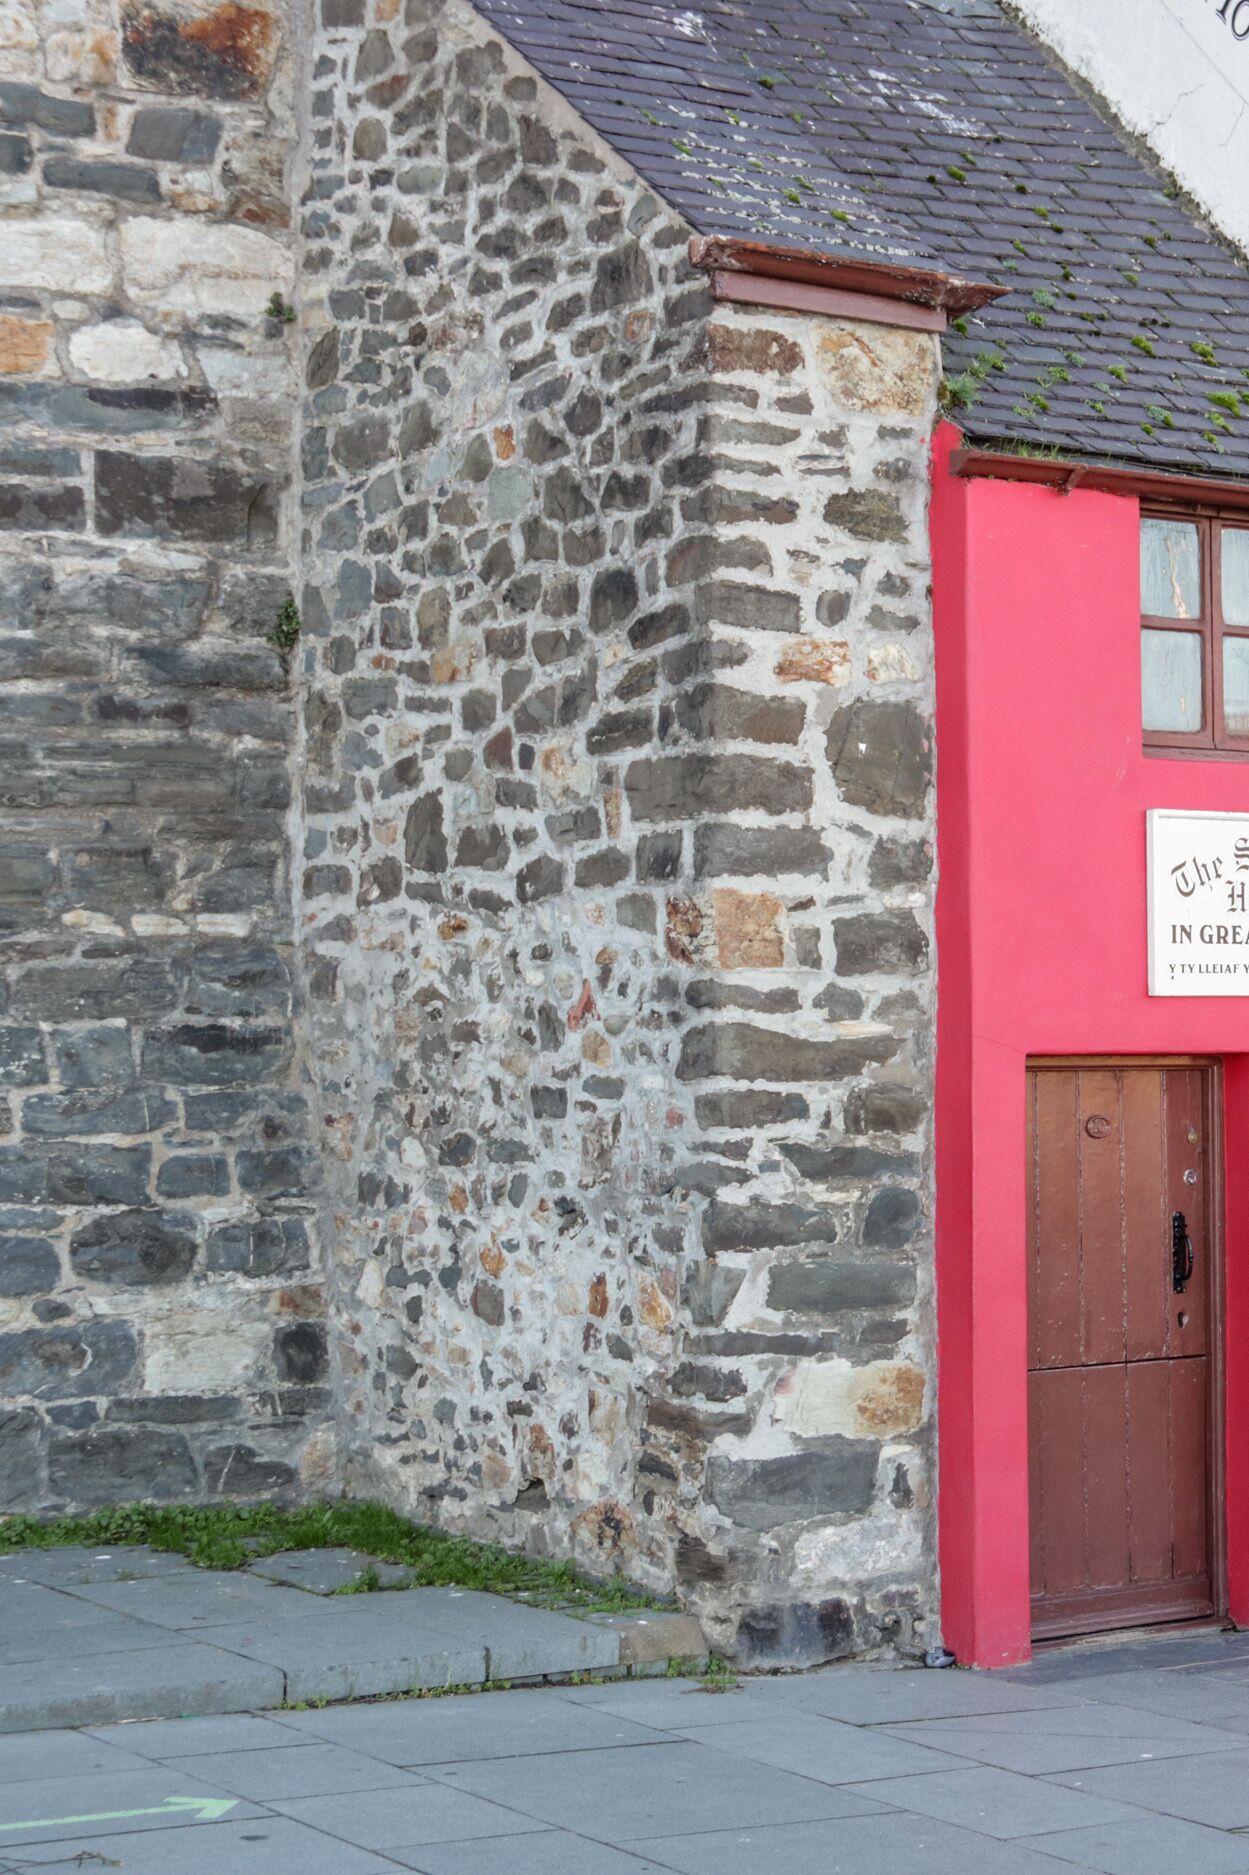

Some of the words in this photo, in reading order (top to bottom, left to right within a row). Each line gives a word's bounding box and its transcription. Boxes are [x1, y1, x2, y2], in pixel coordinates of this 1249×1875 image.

[1170, 856, 1224, 898] The
[1171, 924, 1193, 945] IN
[1168, 963, 1177, 974] Y
[1179, 963, 1195, 974] TY
[1198, 963, 1240, 974] LLEIAF
